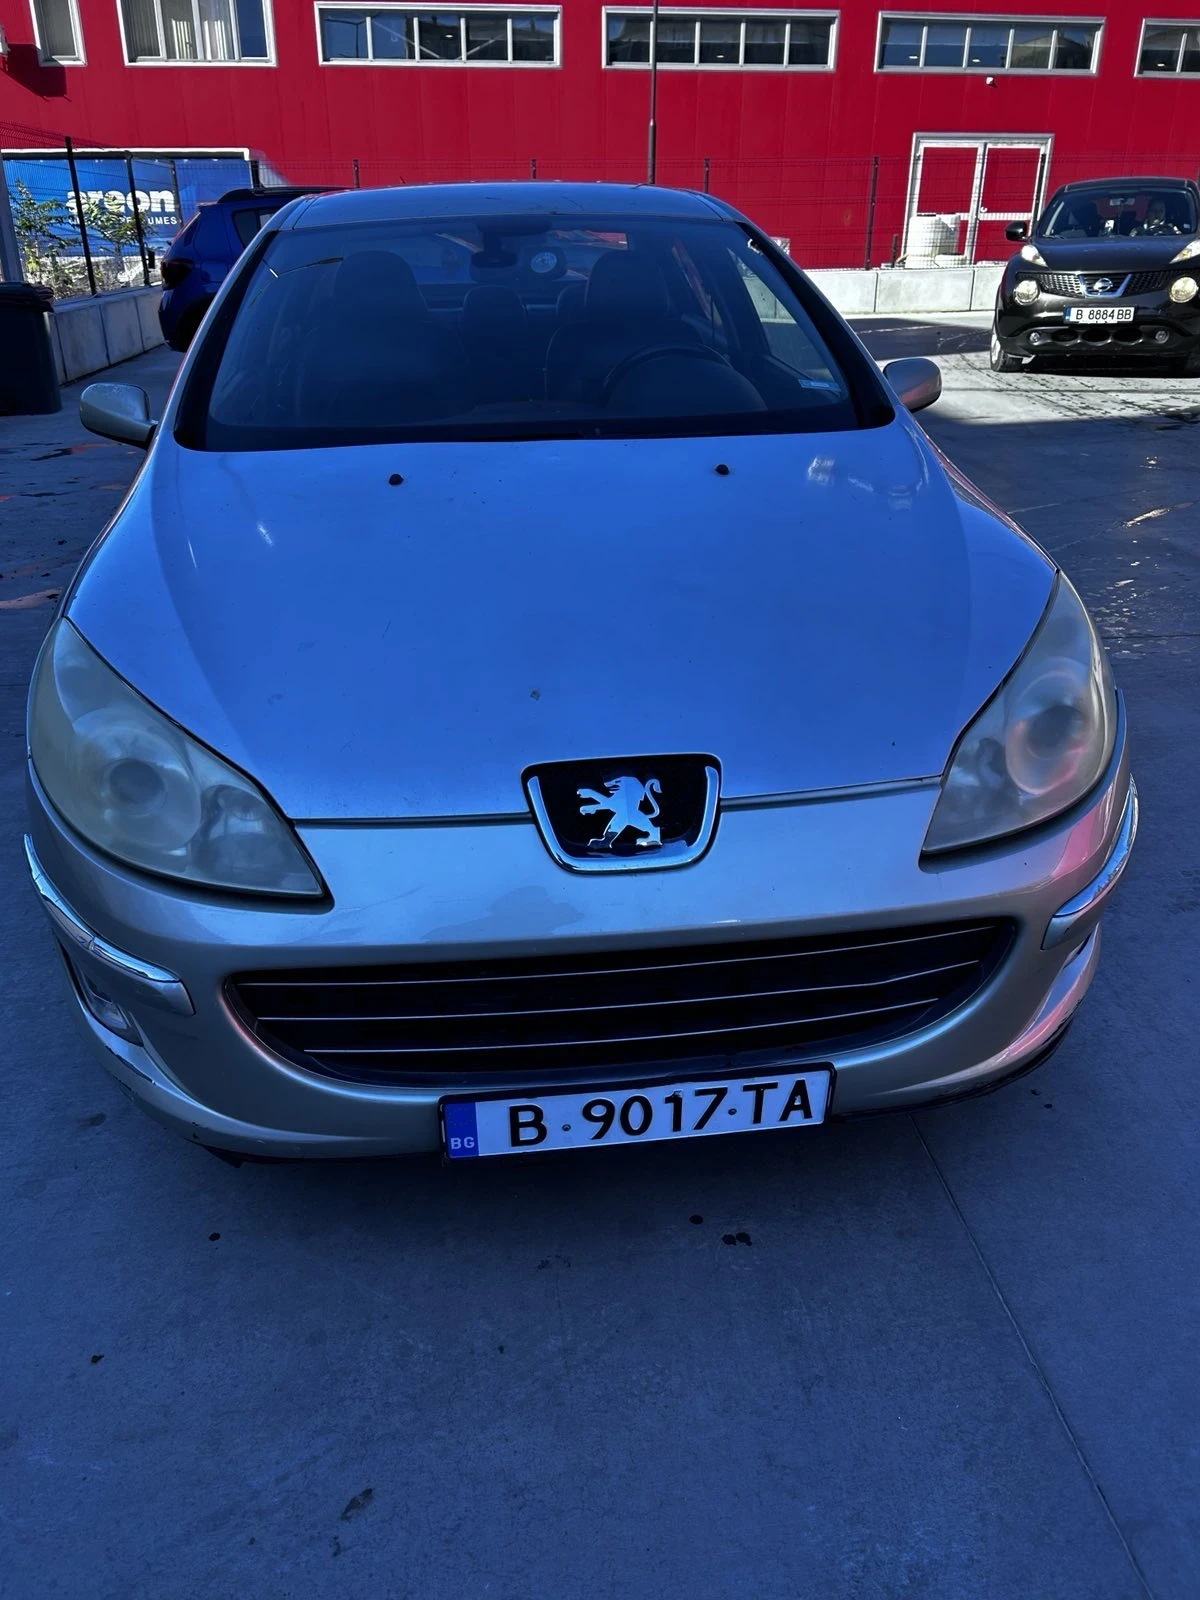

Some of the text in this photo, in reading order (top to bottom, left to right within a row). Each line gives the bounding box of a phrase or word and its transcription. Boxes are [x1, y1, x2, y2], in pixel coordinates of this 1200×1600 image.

[1076, 309, 1132, 320] B 8884 BB
[509, 1079, 813, 1147] B 9017 TA
[450, 1137, 475, 1150] BG
